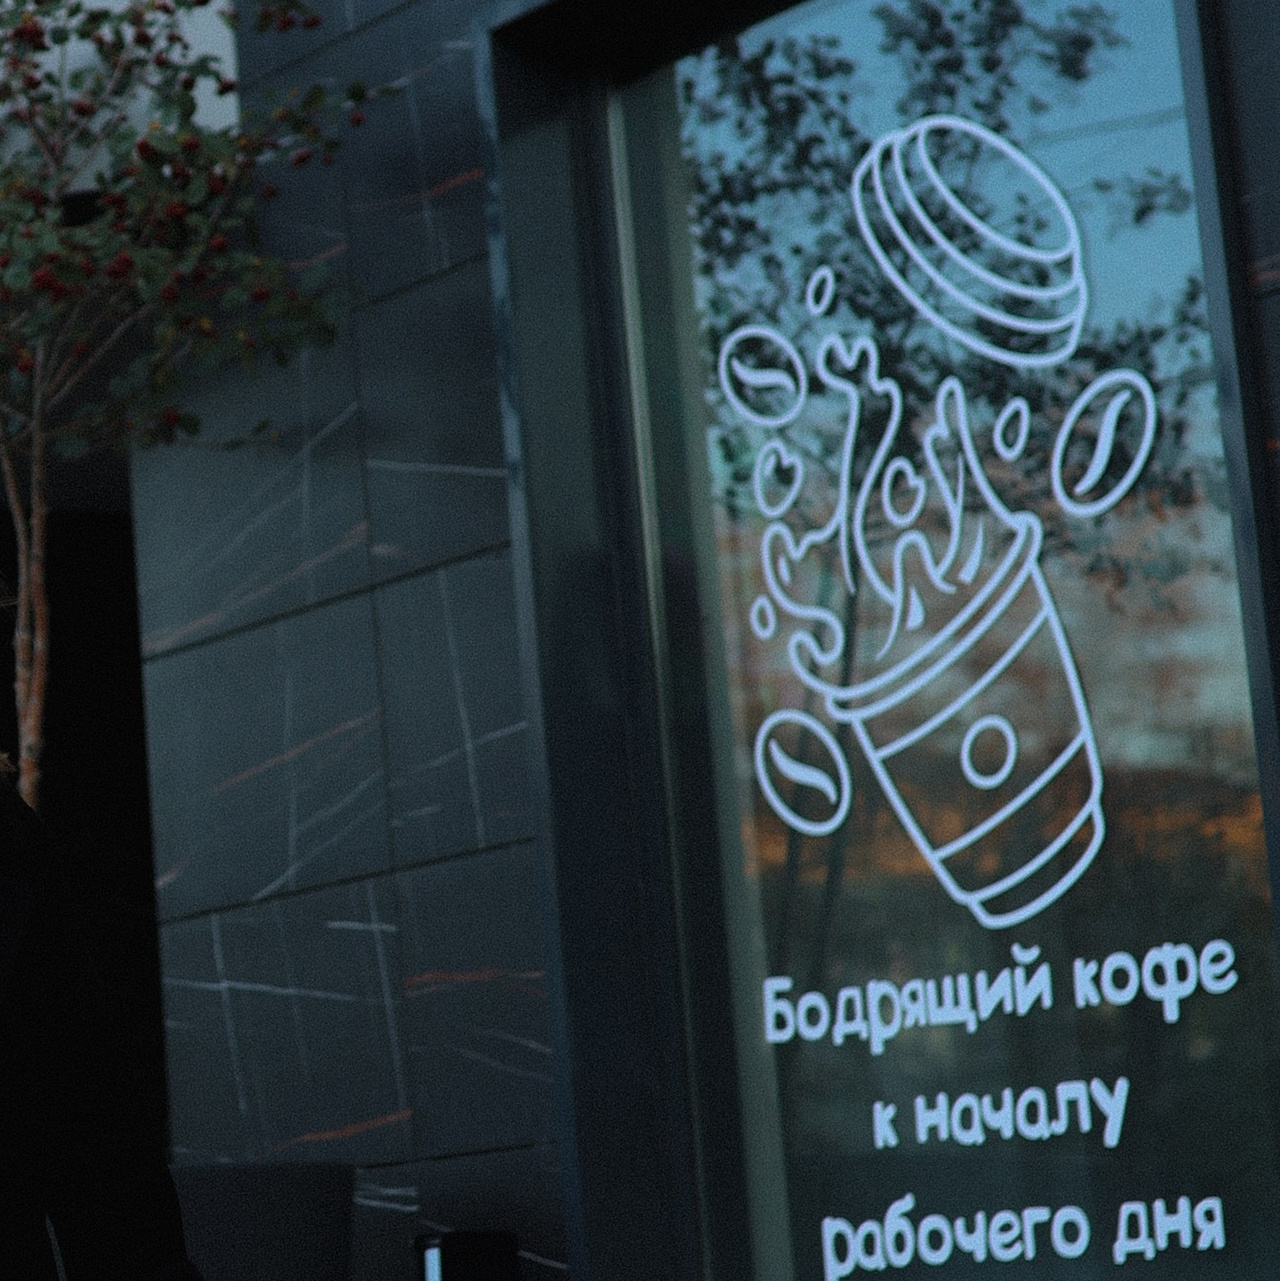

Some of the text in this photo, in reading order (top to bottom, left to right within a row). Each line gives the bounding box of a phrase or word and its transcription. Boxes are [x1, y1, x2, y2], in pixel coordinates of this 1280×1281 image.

[762, 939, 1239, 1056] Бодрящий кофе
[872, 1076, 1130, 1150] к началу
[1112, 1195, 1226, 1265] дня
